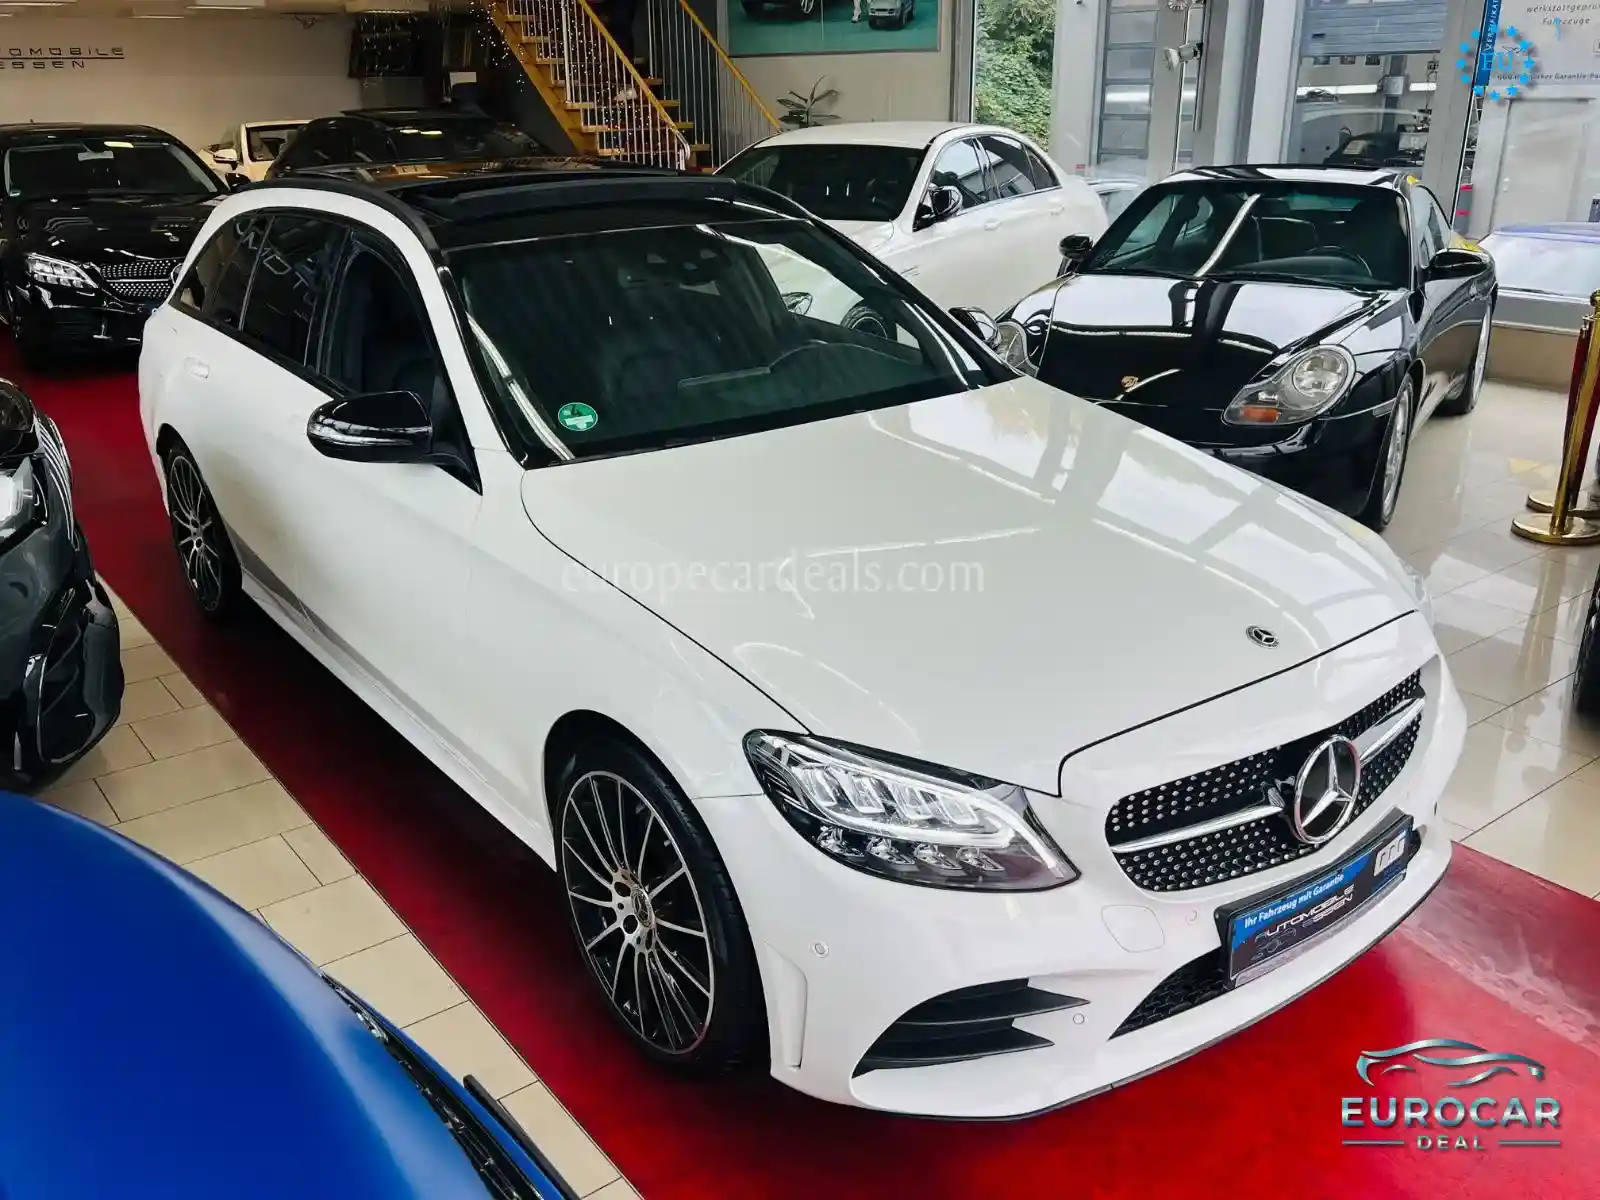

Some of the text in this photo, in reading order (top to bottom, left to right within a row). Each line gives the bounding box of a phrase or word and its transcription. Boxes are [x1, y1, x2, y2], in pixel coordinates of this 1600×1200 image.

[0, 46, 124, 56] OMOBILE
[1244, 873, 1344, 929] Ihr Fahrzeug mit Garantie
